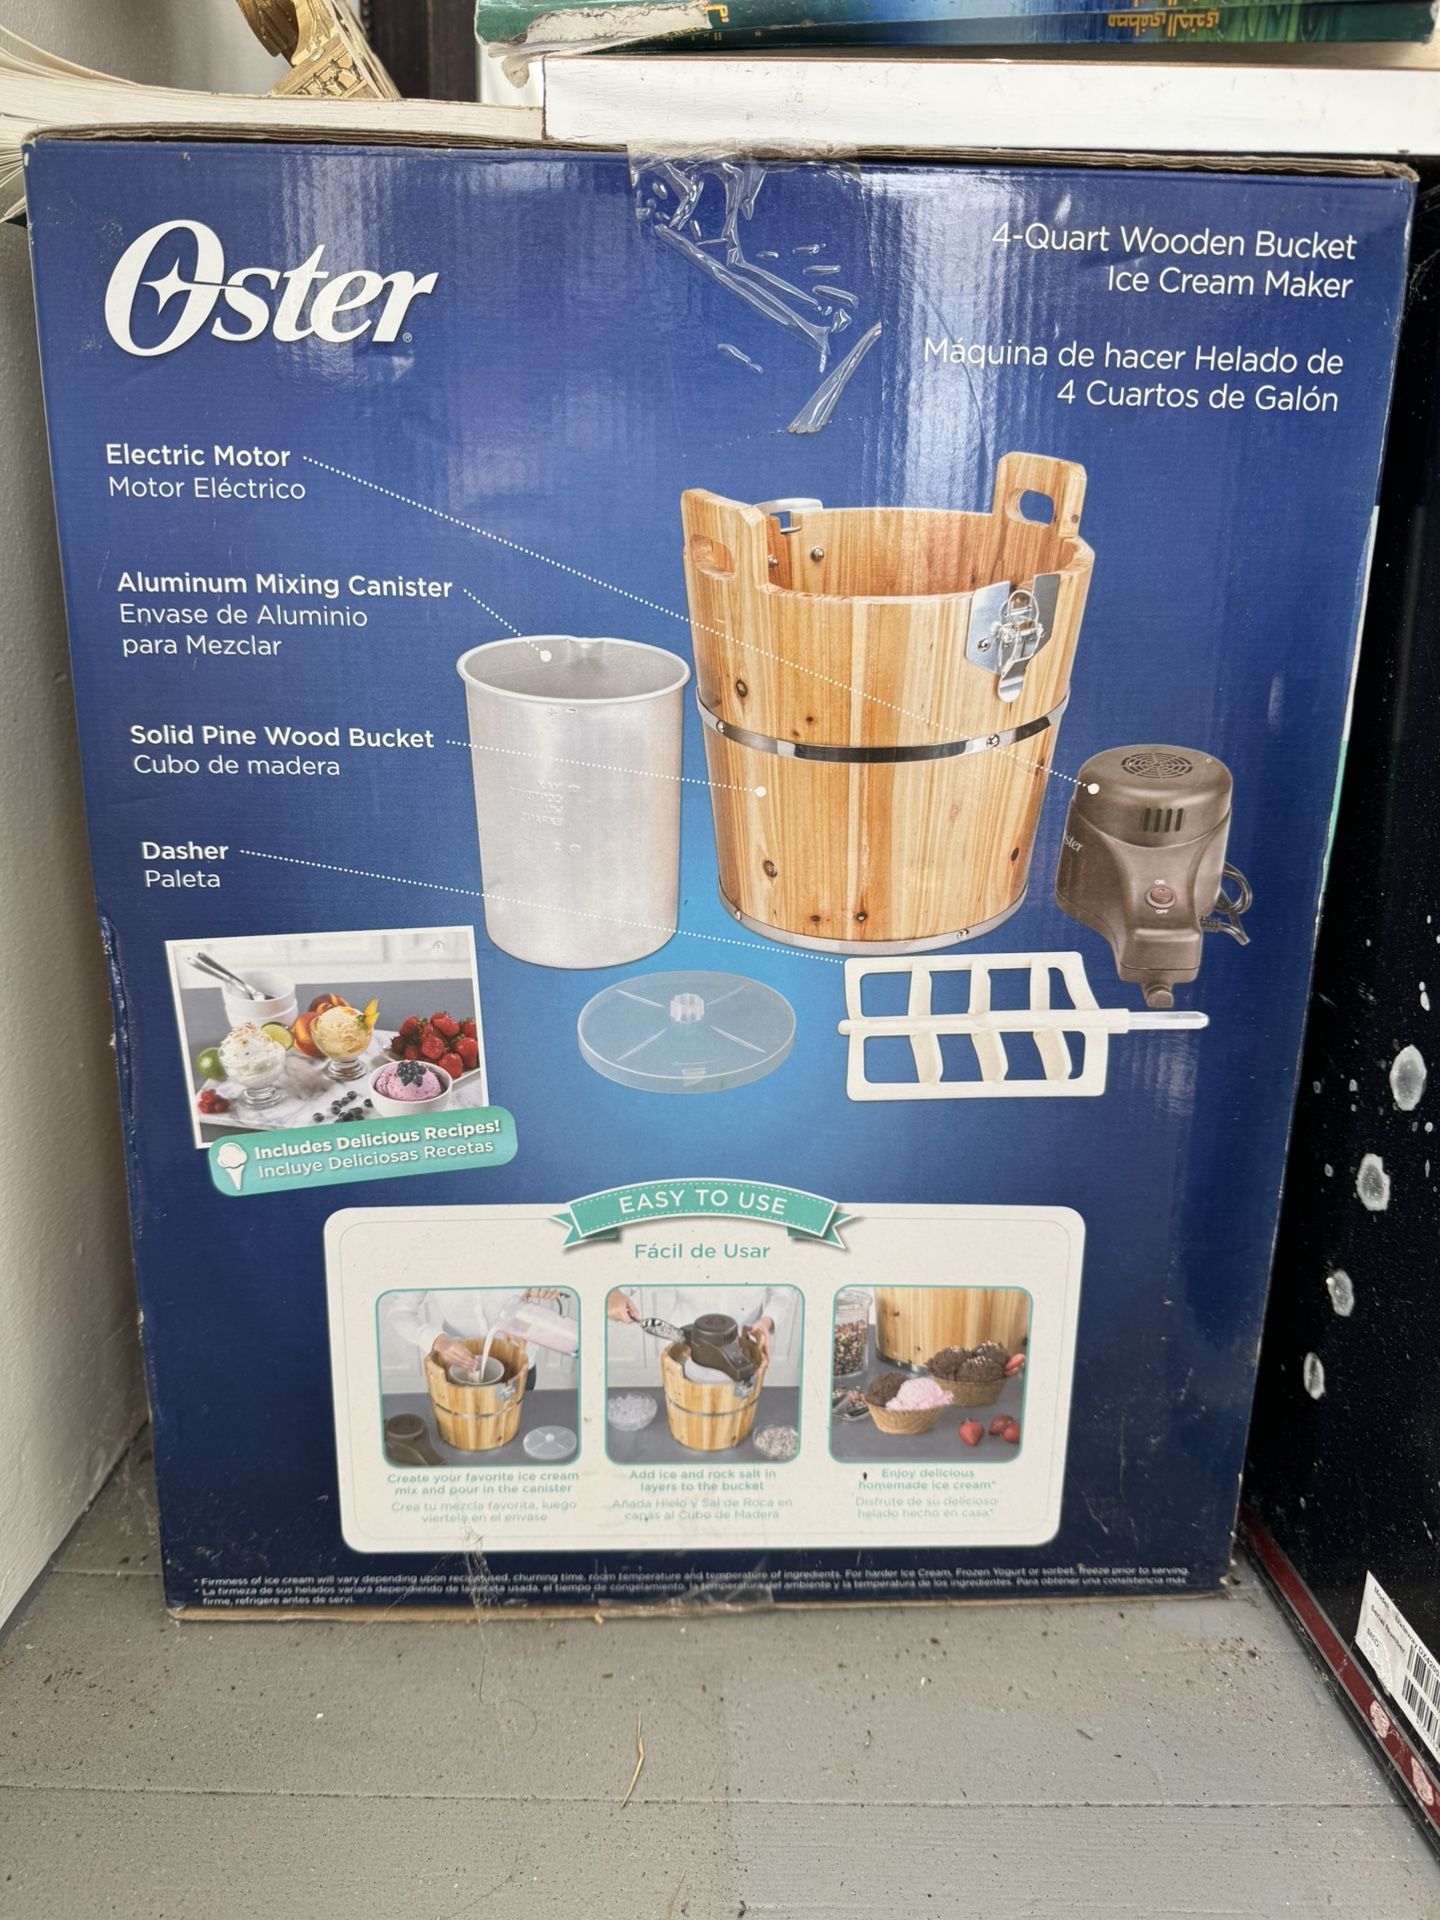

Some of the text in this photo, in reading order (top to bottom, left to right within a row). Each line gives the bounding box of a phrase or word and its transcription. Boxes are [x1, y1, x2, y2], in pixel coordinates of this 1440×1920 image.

[990, 221, 1357, 260] 4-Quart Wooden Bucket
[104, 219, 439, 356] Oster
[1106, 264, 1354, 298] Ice Cream Maker
[925, 337, 1343, 375] Máquina de hacer Helado de
[1057, 379, 1338, 412] 4 Cuartos de Galón
[106, 443, 291, 467] Electric Motor
[109, 476, 306, 499] Motor Eléctrico
[117, 571, 453, 599] Aluminum Mixing Canister
[120, 603, 368, 627] Envase de Aluminio
[123, 635, 282, 658] para Mezclar
[130, 724, 434, 748] Solid Pine Wood Bucket
[134, 754, 340, 776] Cubo de madera
[142, 841, 229, 862] Dasher
[1064, 834, 1084, 853] ster
[145, 869, 221, 888] Paleta
[254, 1120, 500, 1160] Includes Delicious Recipes!
[259, 1141, 493, 1178] Incluye Deliciosas Recetas
[619, 1189, 788, 1216] EASY TO USE
[635, 1243, 770, 1259] Fácil de Usar
[387, 1472, 579, 1484] Create your favorite ice cream
[629, 1469, 776, 1480] Add ice and rock salt in
[881, 1468, 975, 1479] Enjoy delicious
[395, 1483, 572, 1496] mix and pour in the canister
[640, 1481, 764, 1493] layers to the bucket
[858, 1480, 928, 1490] homemade
[932, 1480, 949, 1490] ice
[391, 1500, 577, 1512] Crea tu mezcla favorita, luego
[611, 1497, 793, 1509] Añada Hielo y Sal de Roca en
[855, 1496, 998, 1507] Disfrute de su delicioso
[471, 1514, 487, 1523] en
[490, 1512, 501, 1522] el
[504, 1513, 548, 1522] envase
[624, 1509, 779, 1522] capas al Cubo de Madera
[857, 1509, 900, 1519] helado
[902, 1509, 940, 1518] hecho
[943, 1510, 959, 1518] en
